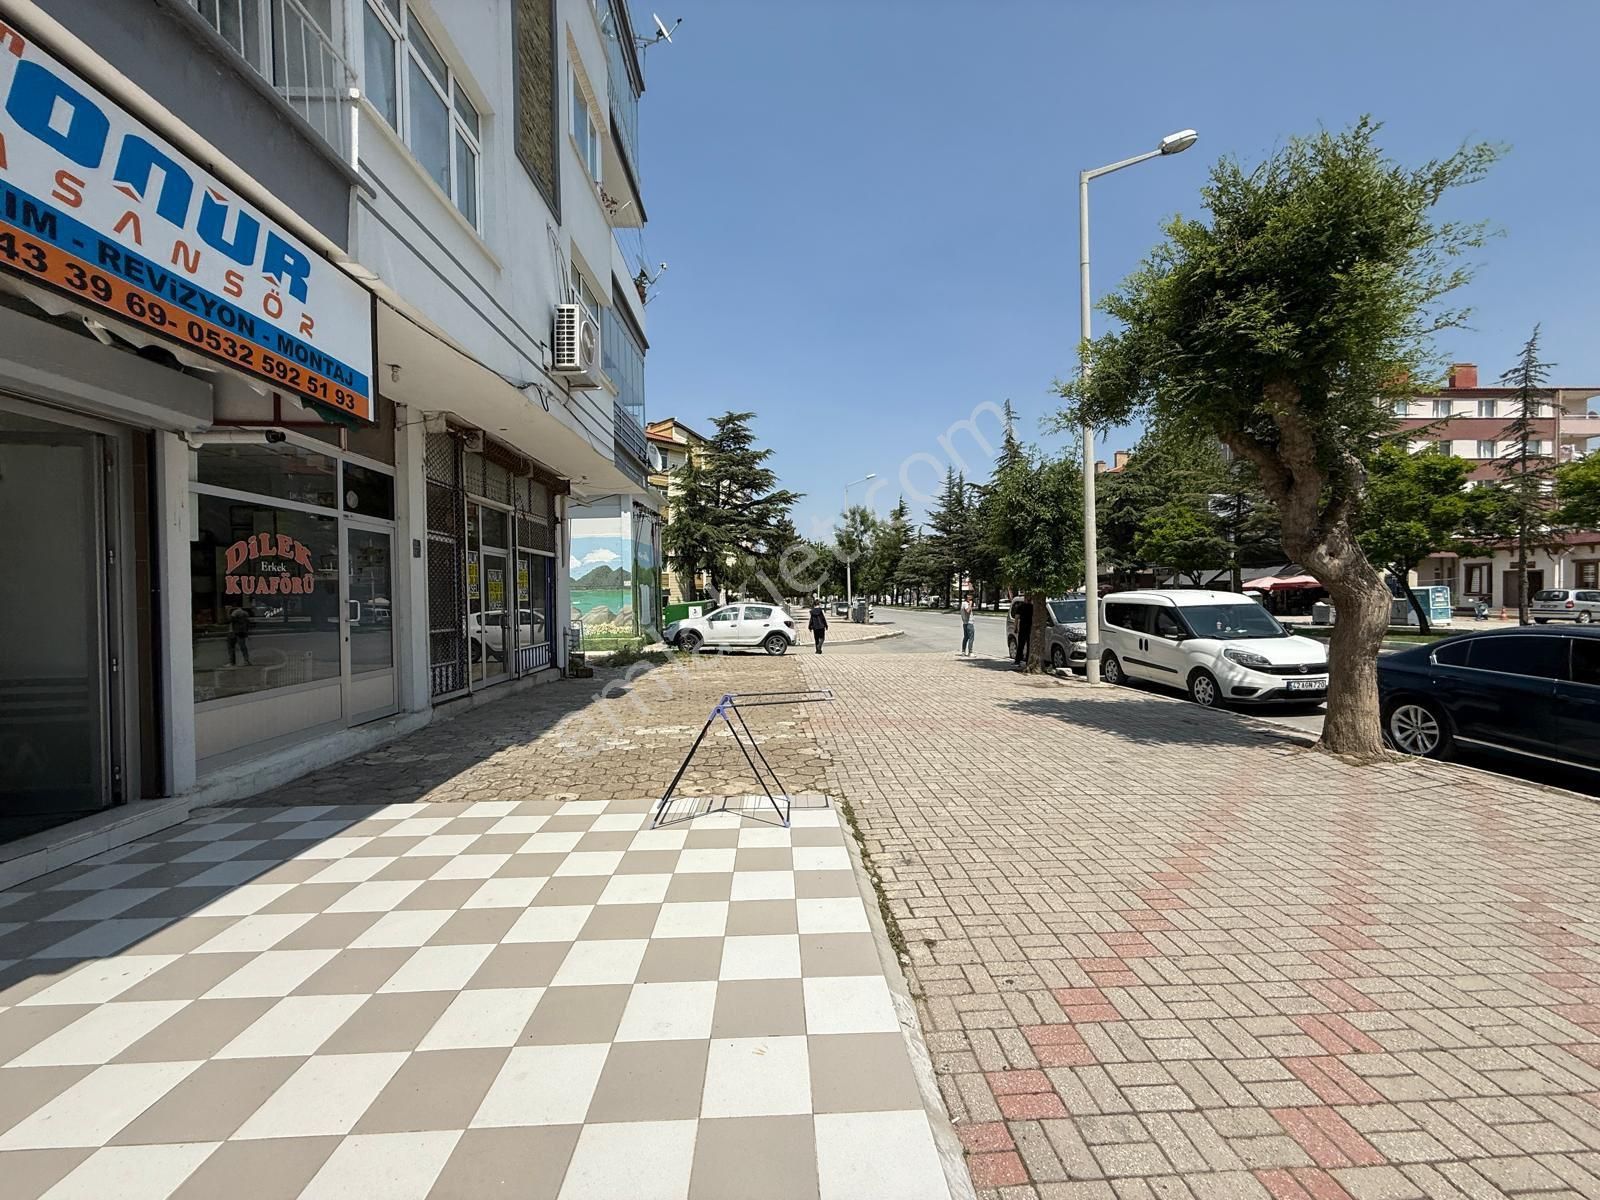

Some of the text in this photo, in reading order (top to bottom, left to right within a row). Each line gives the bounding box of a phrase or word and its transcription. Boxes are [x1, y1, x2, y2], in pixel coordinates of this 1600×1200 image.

[63, 261, 113, 303] 39
[187, 320, 254, 367] 0532
[261, 354, 301, 388] 592
[306, 376, 329, 399] 51
[334, 388, 356, 411] 93
[276, 331, 354, 388] MONTAJ
[225, 572, 315, 595] KUAFÖRÜ
[261, 561, 287, 572] Erkek
